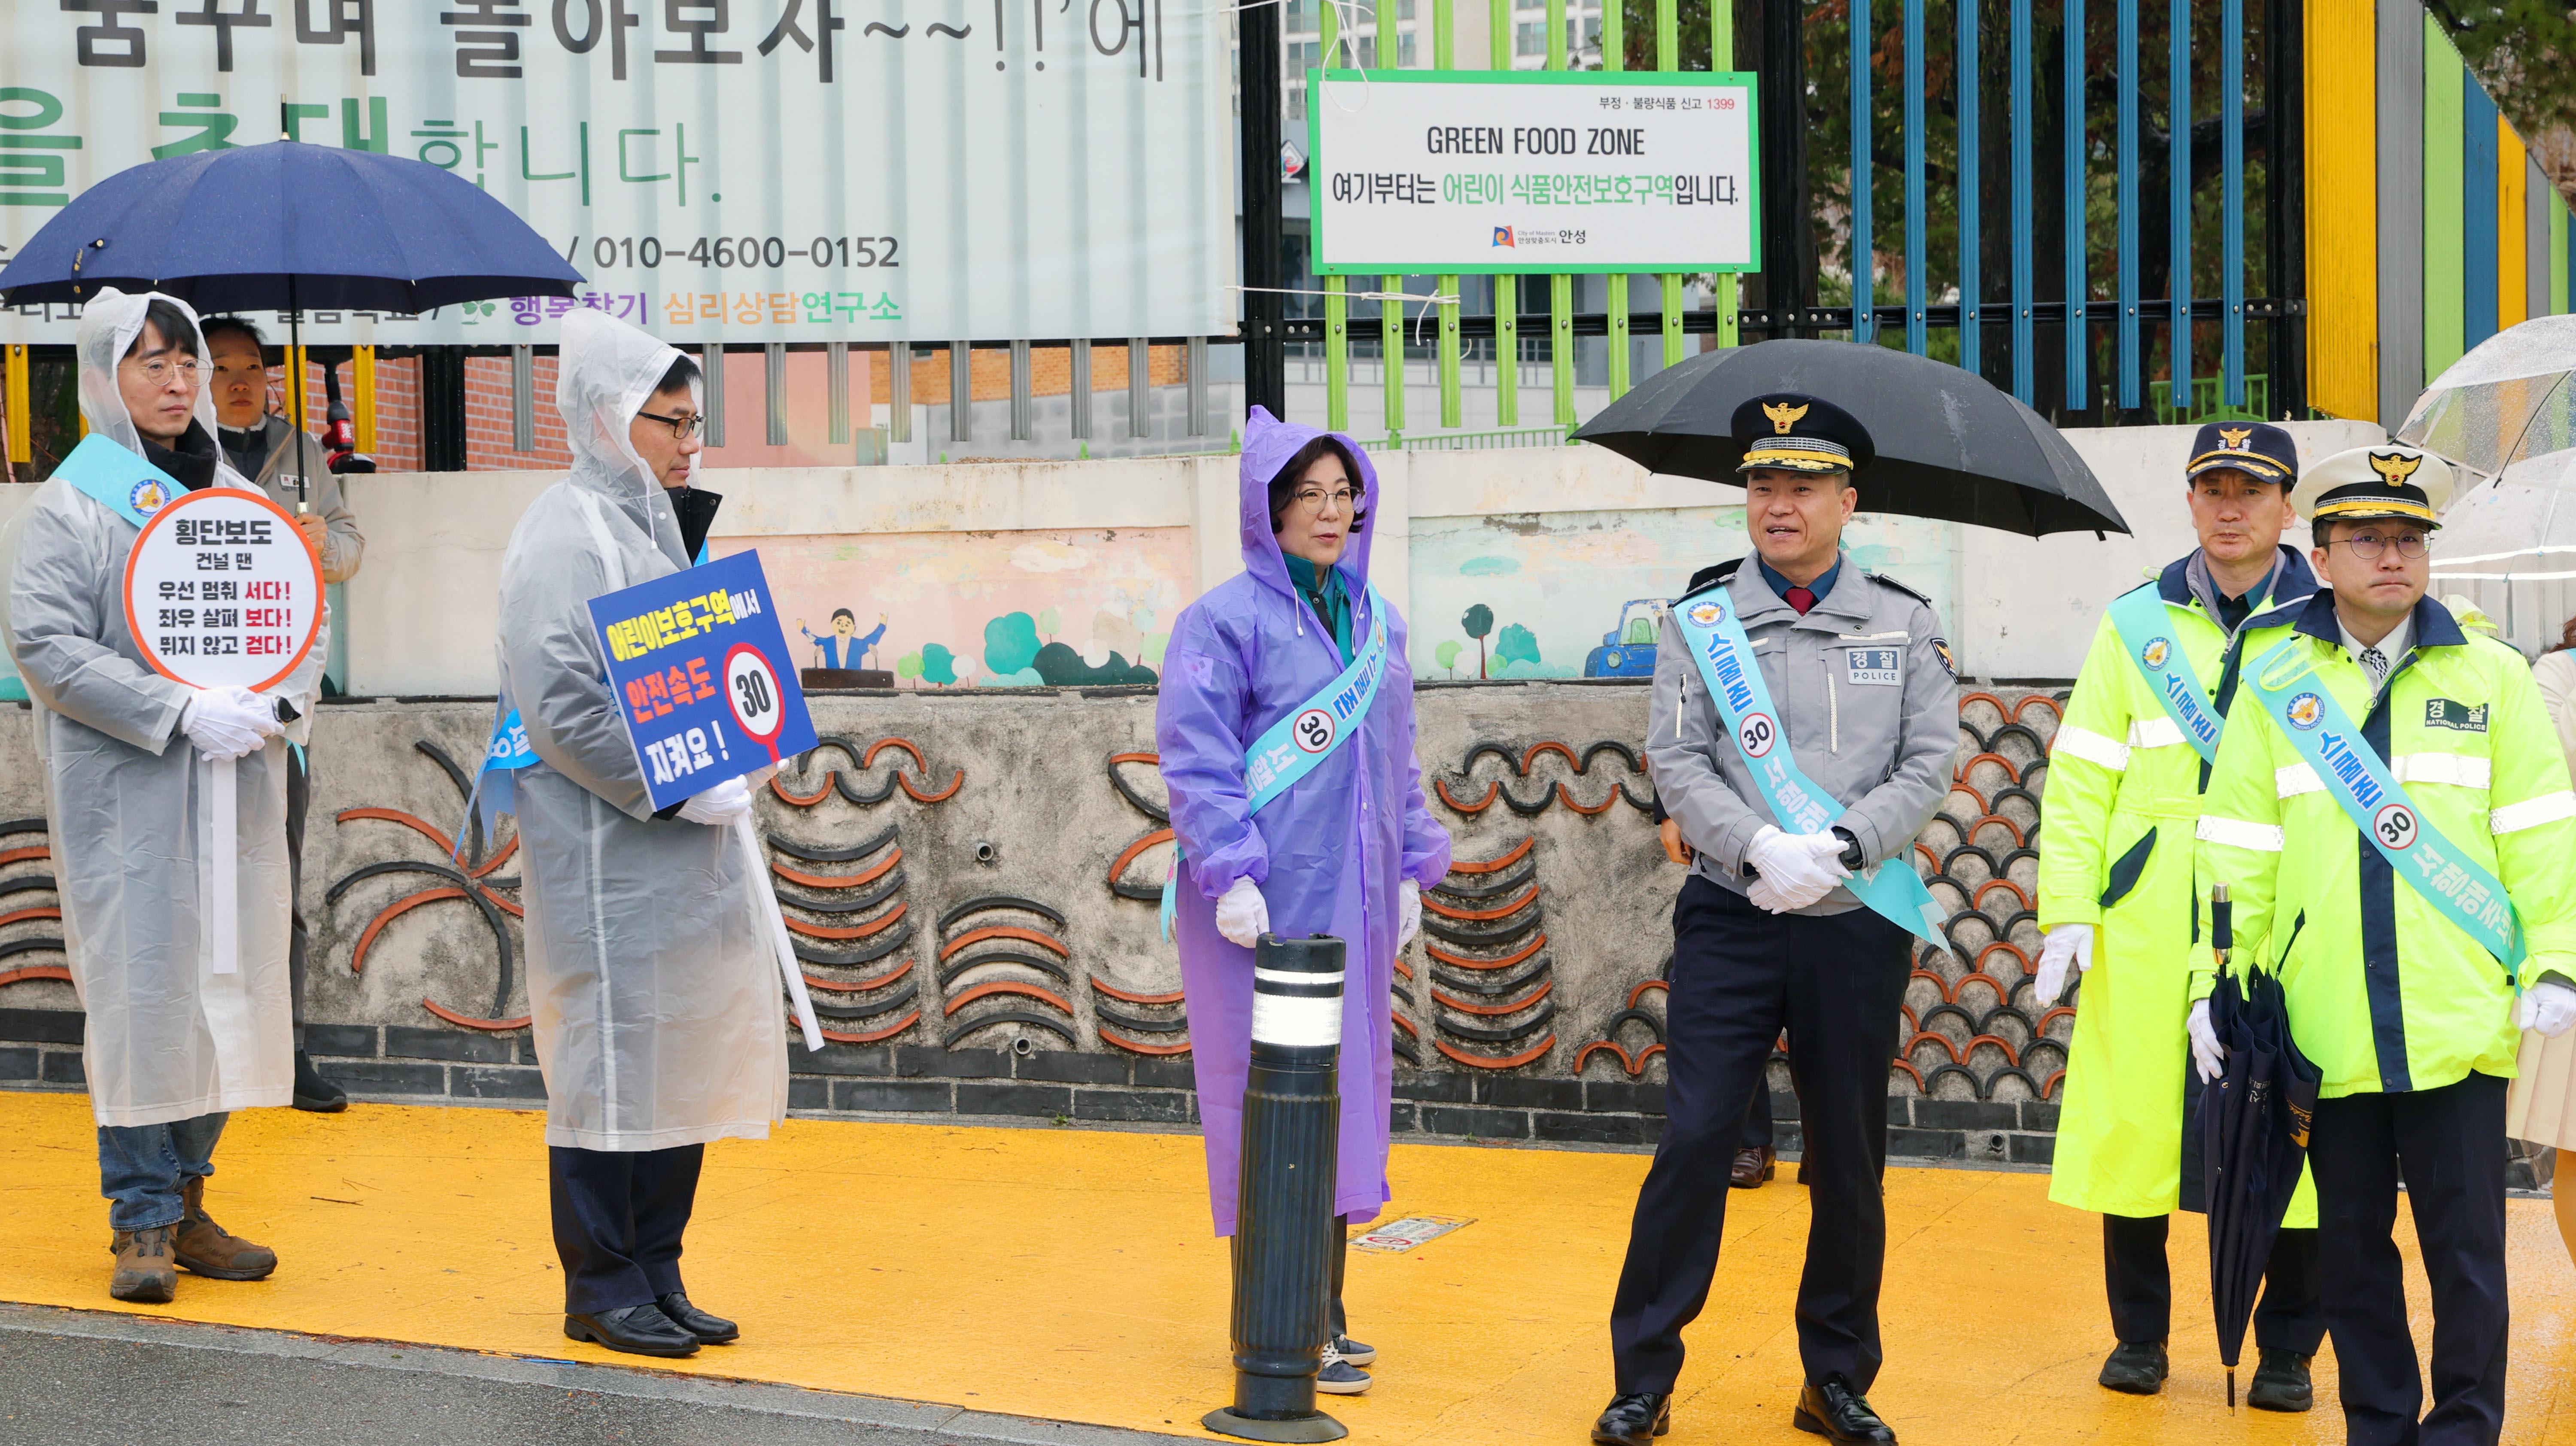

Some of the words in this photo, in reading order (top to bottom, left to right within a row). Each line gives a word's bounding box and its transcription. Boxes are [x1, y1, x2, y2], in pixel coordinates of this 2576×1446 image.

[1599, 96, 1621, 110] 부정
[1633, 96, 1677, 111] 불량식품
[1680, 97, 1702, 111] 신고
[1707, 98, 1735, 110] 1399
[1427, 126, 1503, 155] GREEN
[1514, 128, 1576, 155] FOOD
[1587, 128, 1645, 155] ZONE
[1333, 173, 1436, 205] 여기부터는
[1443, 173, 1504, 205] 어린이
[1511, 174, 1739, 206] 식품안전보호구역입니다.
[1559, 230, 1586, 244] 안성
[594, 237, 900, 268] 010-4600-0152
[663, 292, 902, 325] 심리상담연구소
[176, 519, 272, 545] 횡단보도
[197, 553, 229, 570] 건널
[159, 581, 194, 600] 우선
[202, 581, 237, 600] 멈춰
[245, 581, 290, 600] 서다!
[159, 609, 194, 628] 좌우
[203, 609, 238, 628] 살펴
[246, 609, 291, 627] 보다!
[606, 588, 762, 662] 어린이보호구역에서
[160, 636, 195, 656] 뛰지
[203, 636, 238, 656] 않고
[246, 636, 291, 655] 걷다!
[1852, 651, 1895, 669] 경찰
[626, 656, 716, 724] 안전속도
[1707, 632, 1756, 715] 스쿨존
[1744, 722, 1770, 749] 30
[1853, 672, 1896, 681] POLICE
[736, 669, 771, 717] 30
[2165, 673, 2218, 746] 스쿨존
[2426, 719, 2459, 729] NATIONAL
[1300, 716, 1328, 746] 30
[2319, 731, 2387, 811] 스쿨존
[2380, 811, 2412, 844] 30
